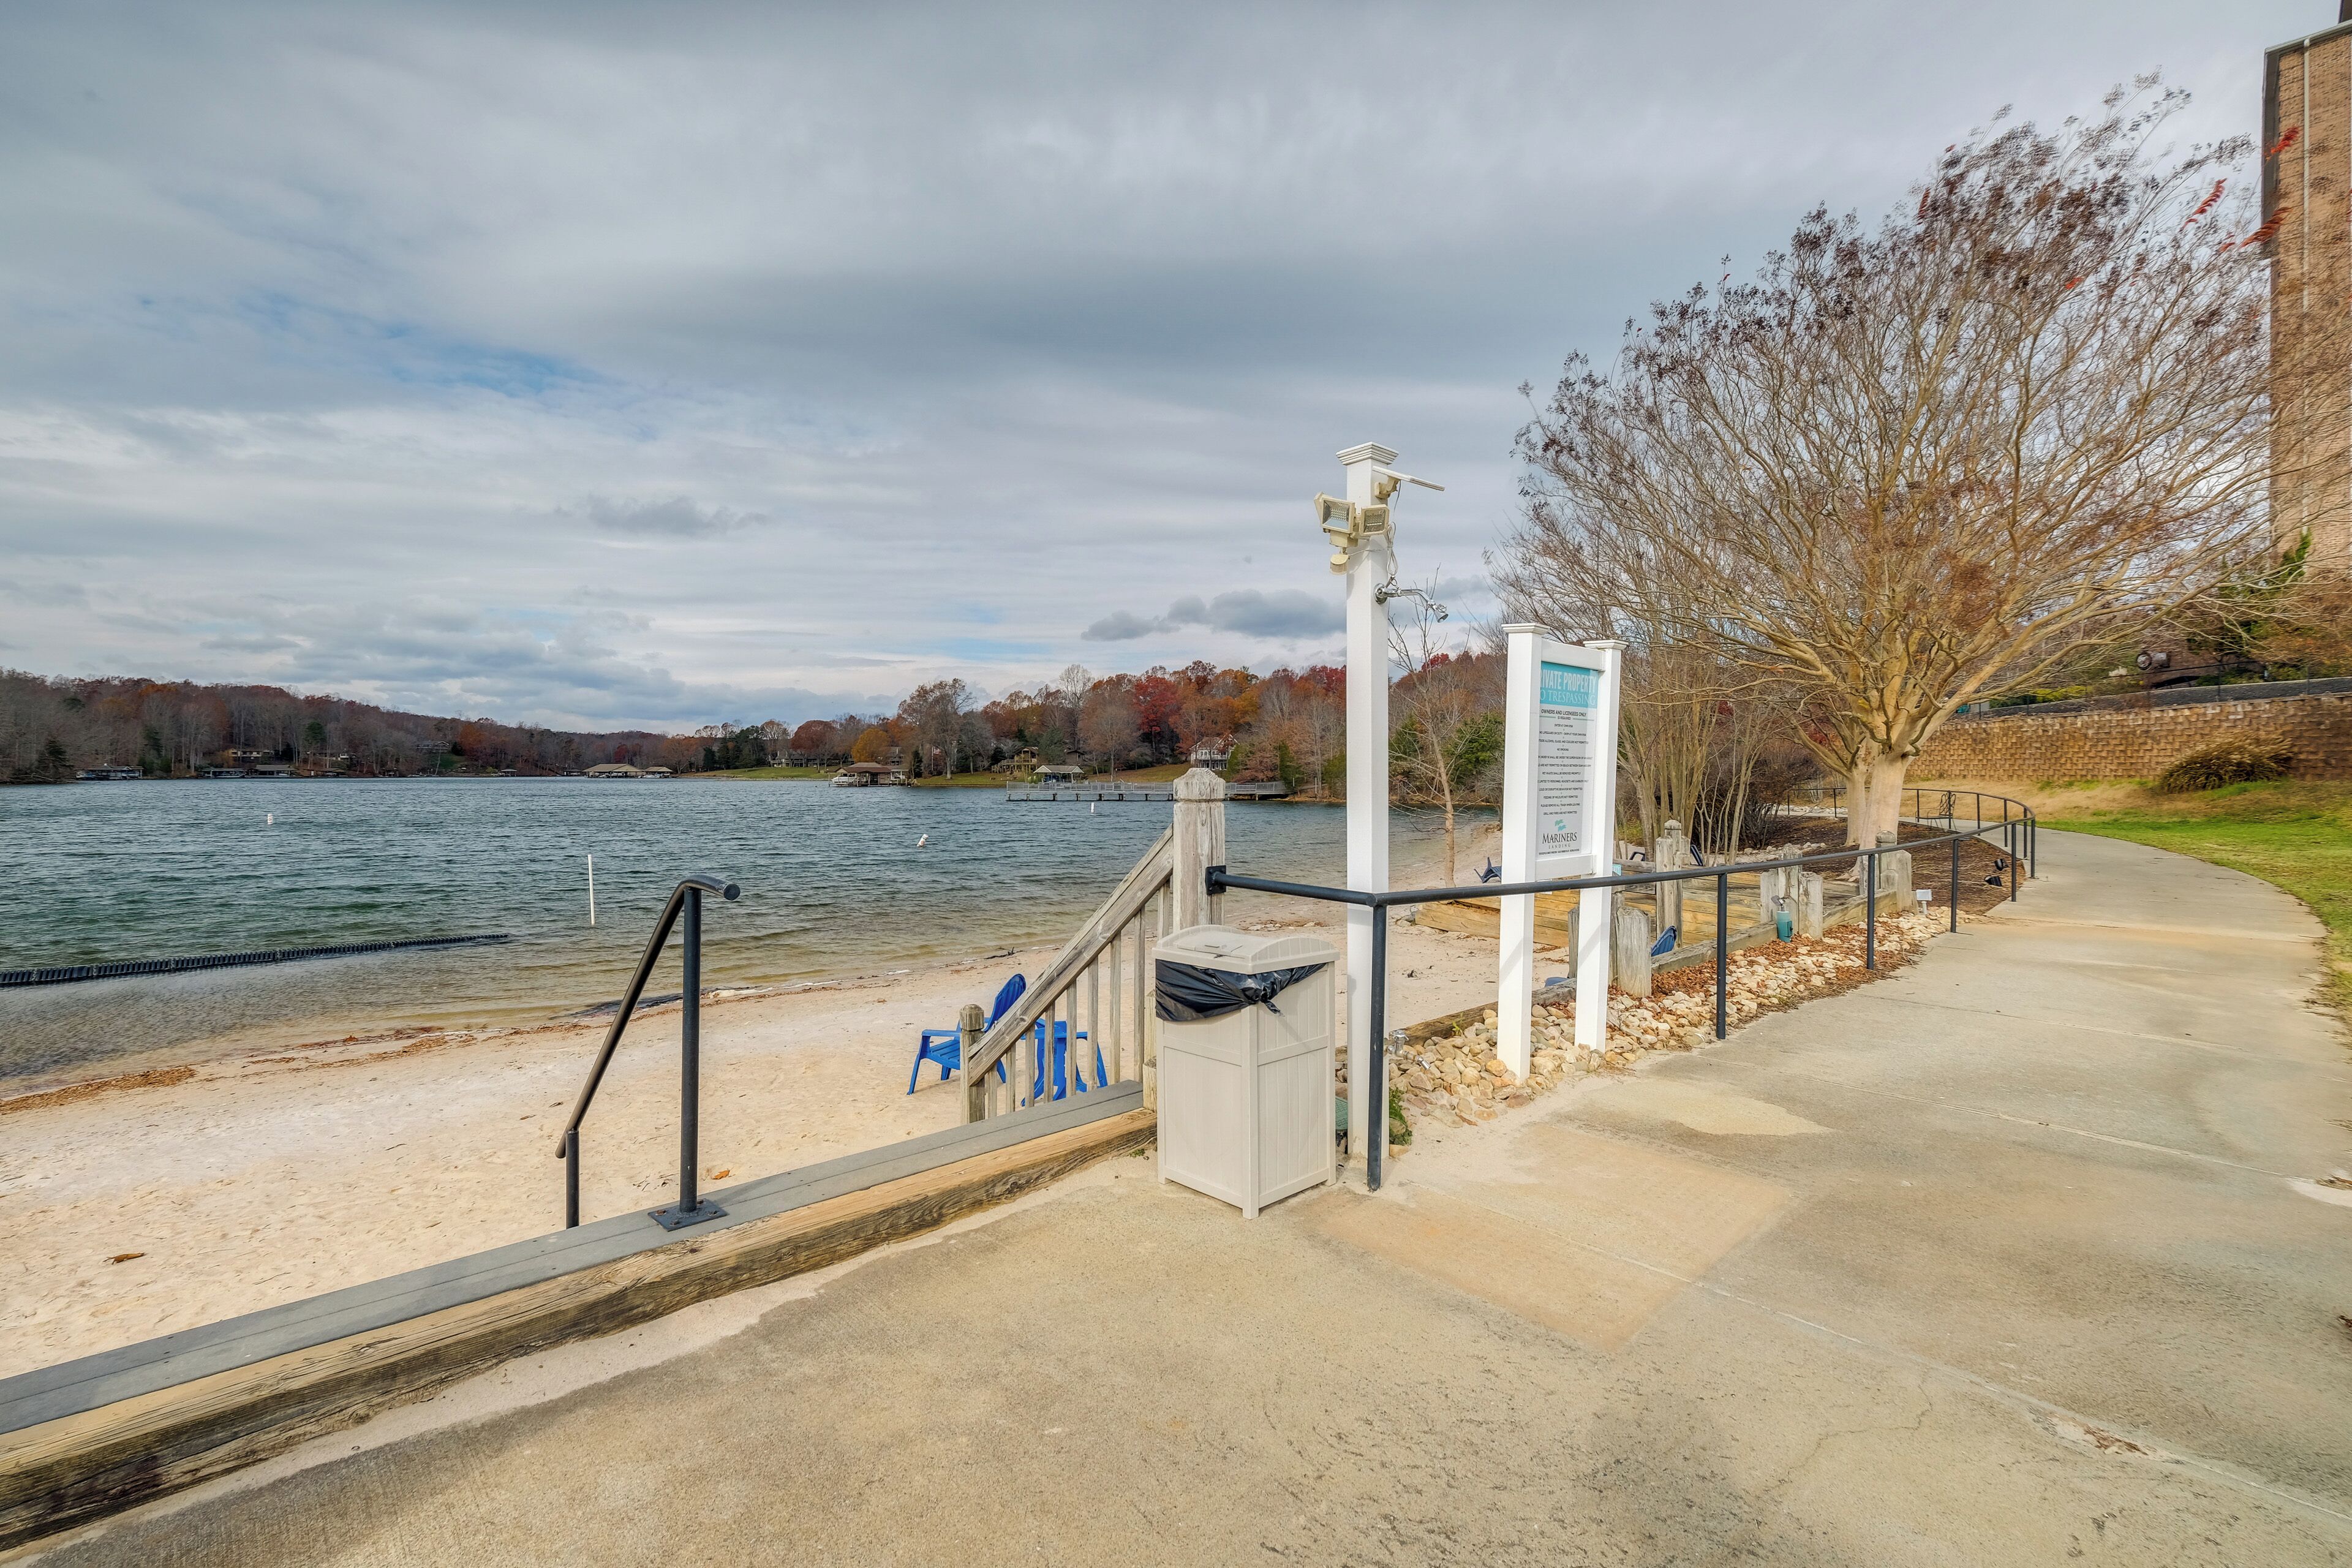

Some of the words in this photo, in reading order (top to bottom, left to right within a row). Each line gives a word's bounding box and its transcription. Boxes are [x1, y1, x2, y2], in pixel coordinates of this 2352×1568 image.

[1563, 673, 1596, 693] PROPERTY
[1548, 690, 1595, 705] TRESPASSING
[1542, 832, 1577, 844] MARINERS
